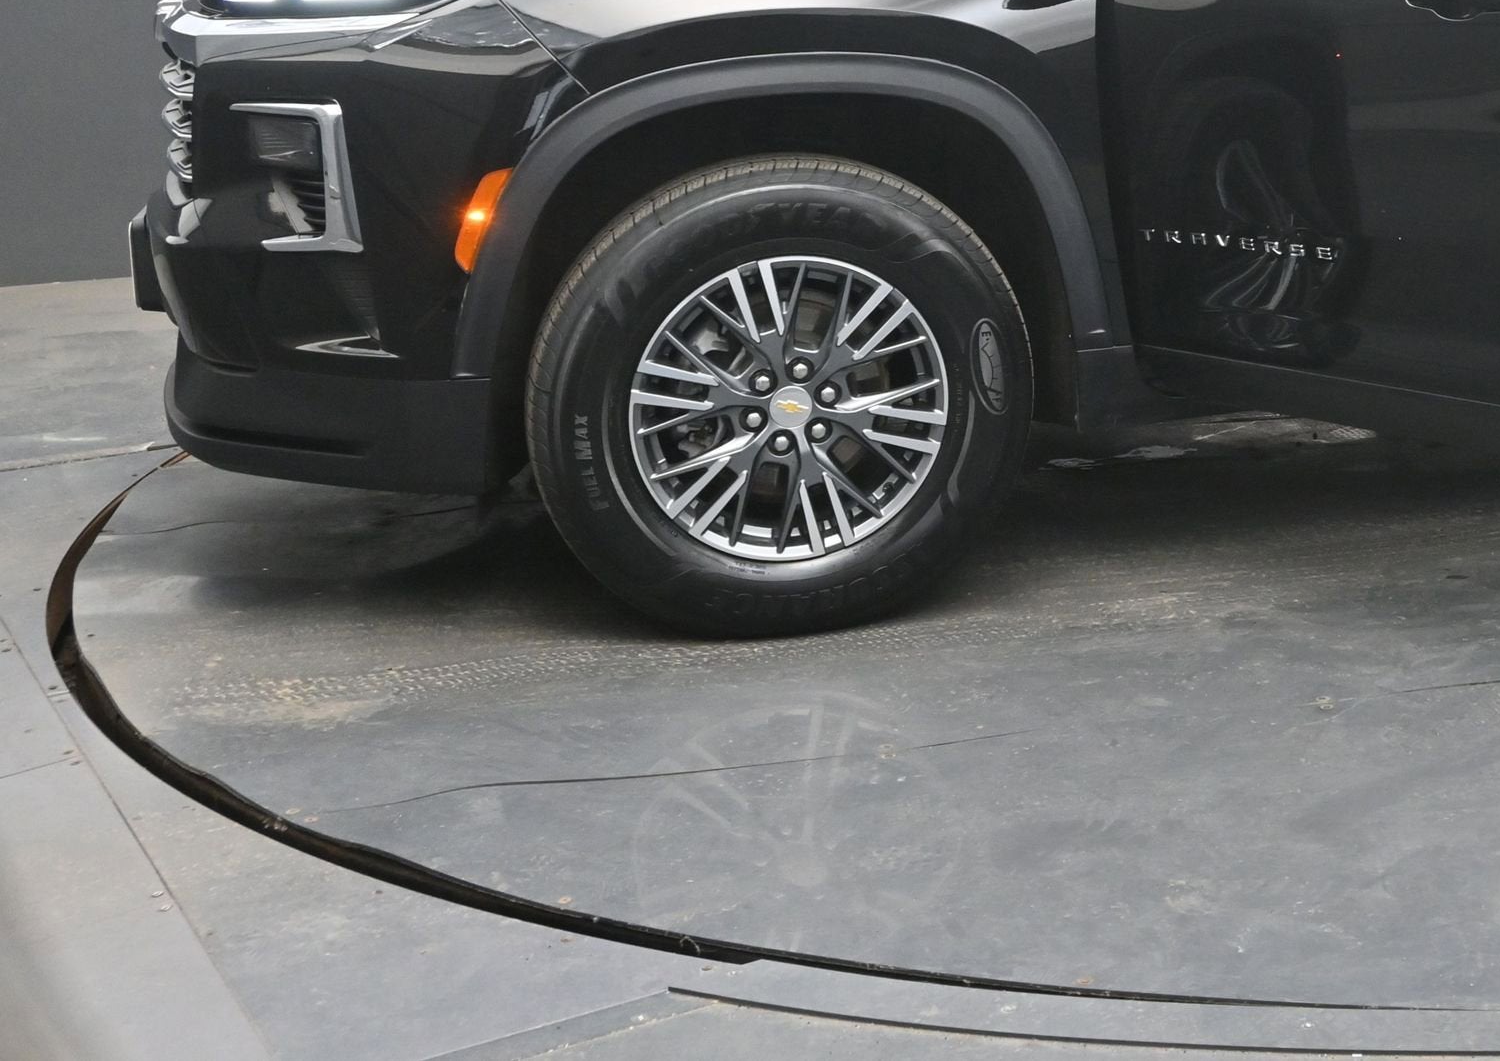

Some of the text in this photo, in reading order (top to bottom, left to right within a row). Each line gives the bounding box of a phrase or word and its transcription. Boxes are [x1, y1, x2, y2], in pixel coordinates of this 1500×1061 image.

[1138, 227, 1333, 261] TRAVERSE
[574, 413, 610, 511] FUEL MAX
